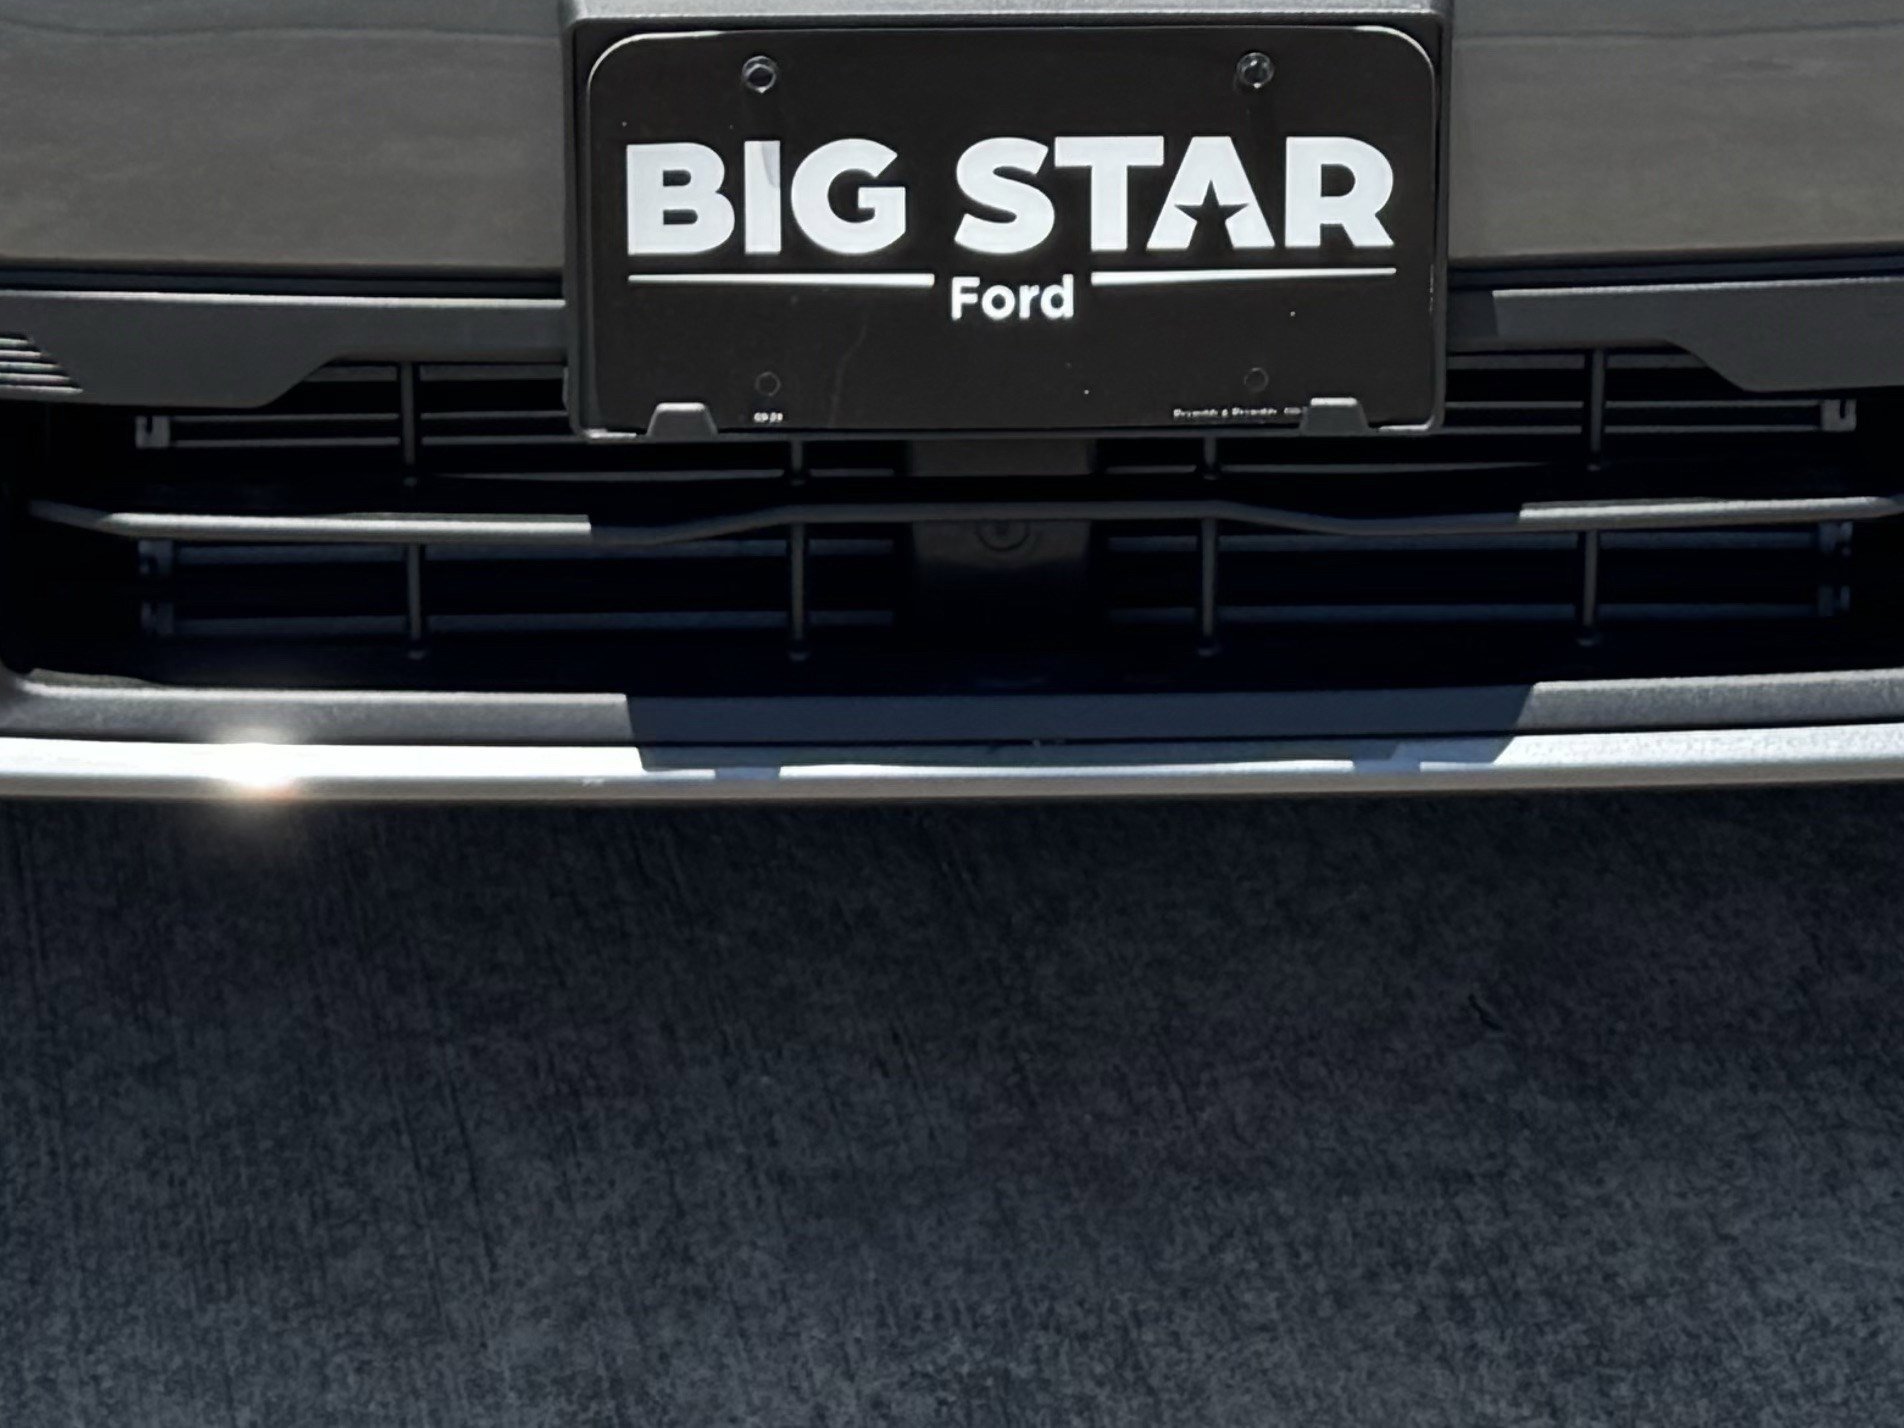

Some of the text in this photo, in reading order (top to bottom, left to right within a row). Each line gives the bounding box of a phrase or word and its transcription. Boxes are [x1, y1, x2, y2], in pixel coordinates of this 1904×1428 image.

[626, 135, 1396, 256] BIG STAR
[950, 273, 1075, 321] Ford
